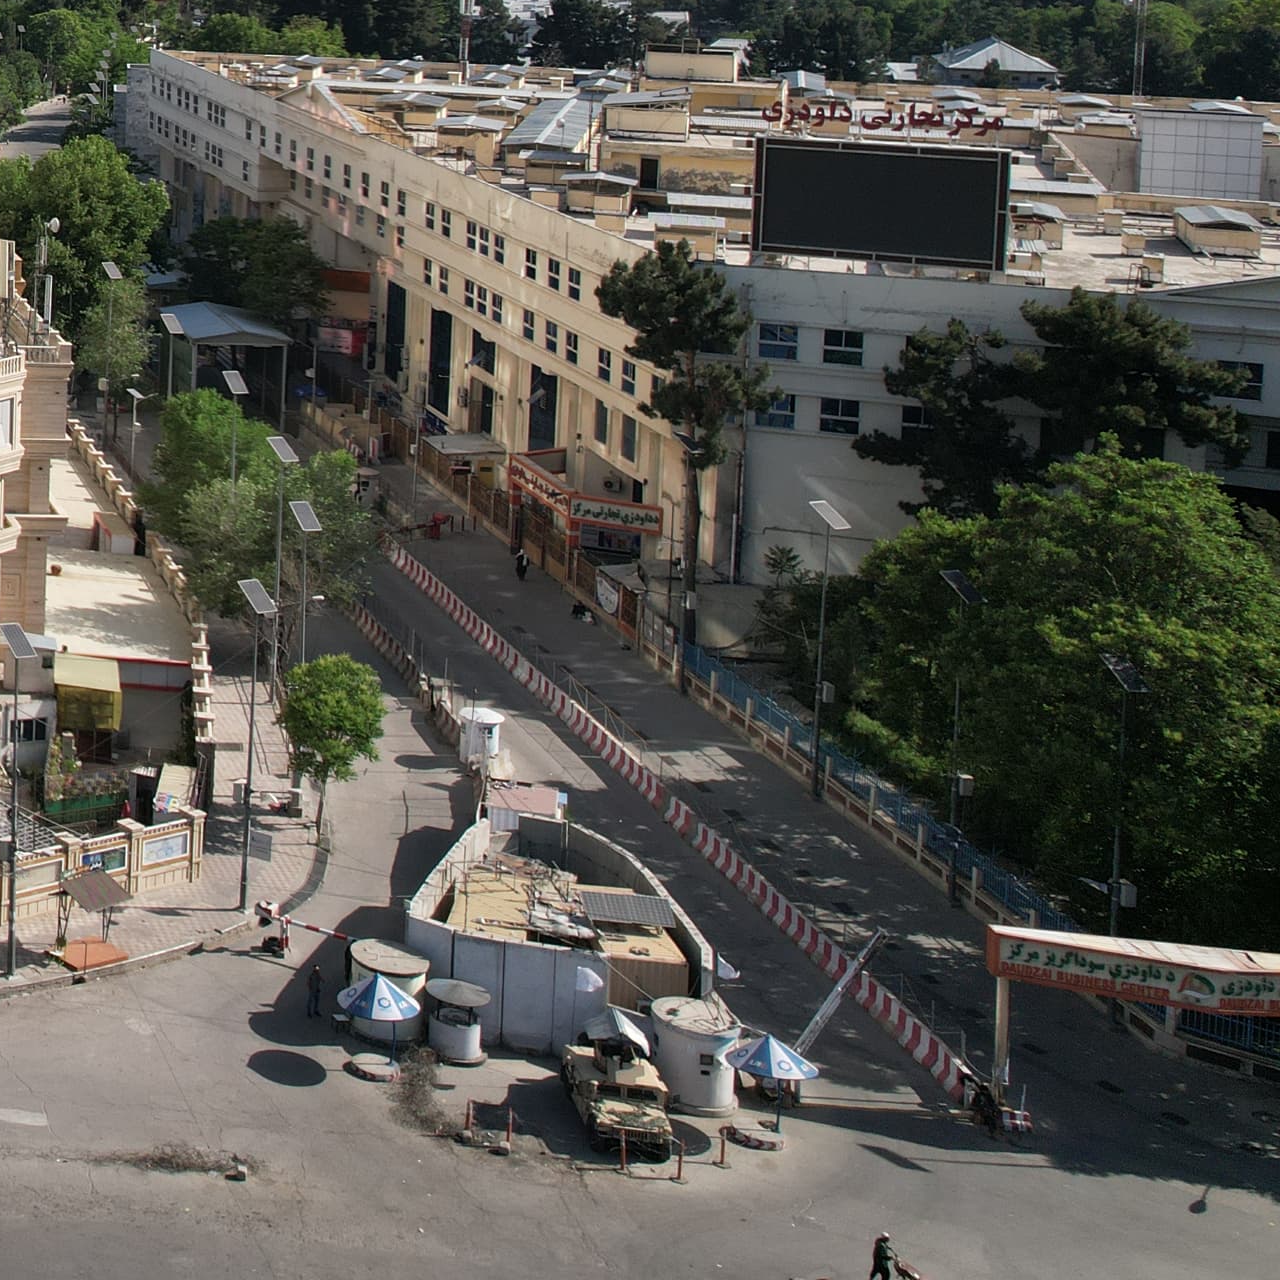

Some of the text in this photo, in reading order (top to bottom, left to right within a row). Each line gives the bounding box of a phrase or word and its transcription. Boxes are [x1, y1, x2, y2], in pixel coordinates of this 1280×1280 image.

[761, 99, 1003, 136] مرکز تجارتی داودزی
[1008, 943, 1040, 963] مرکز
[1056, 970, 1116, 992] BUSINESS
